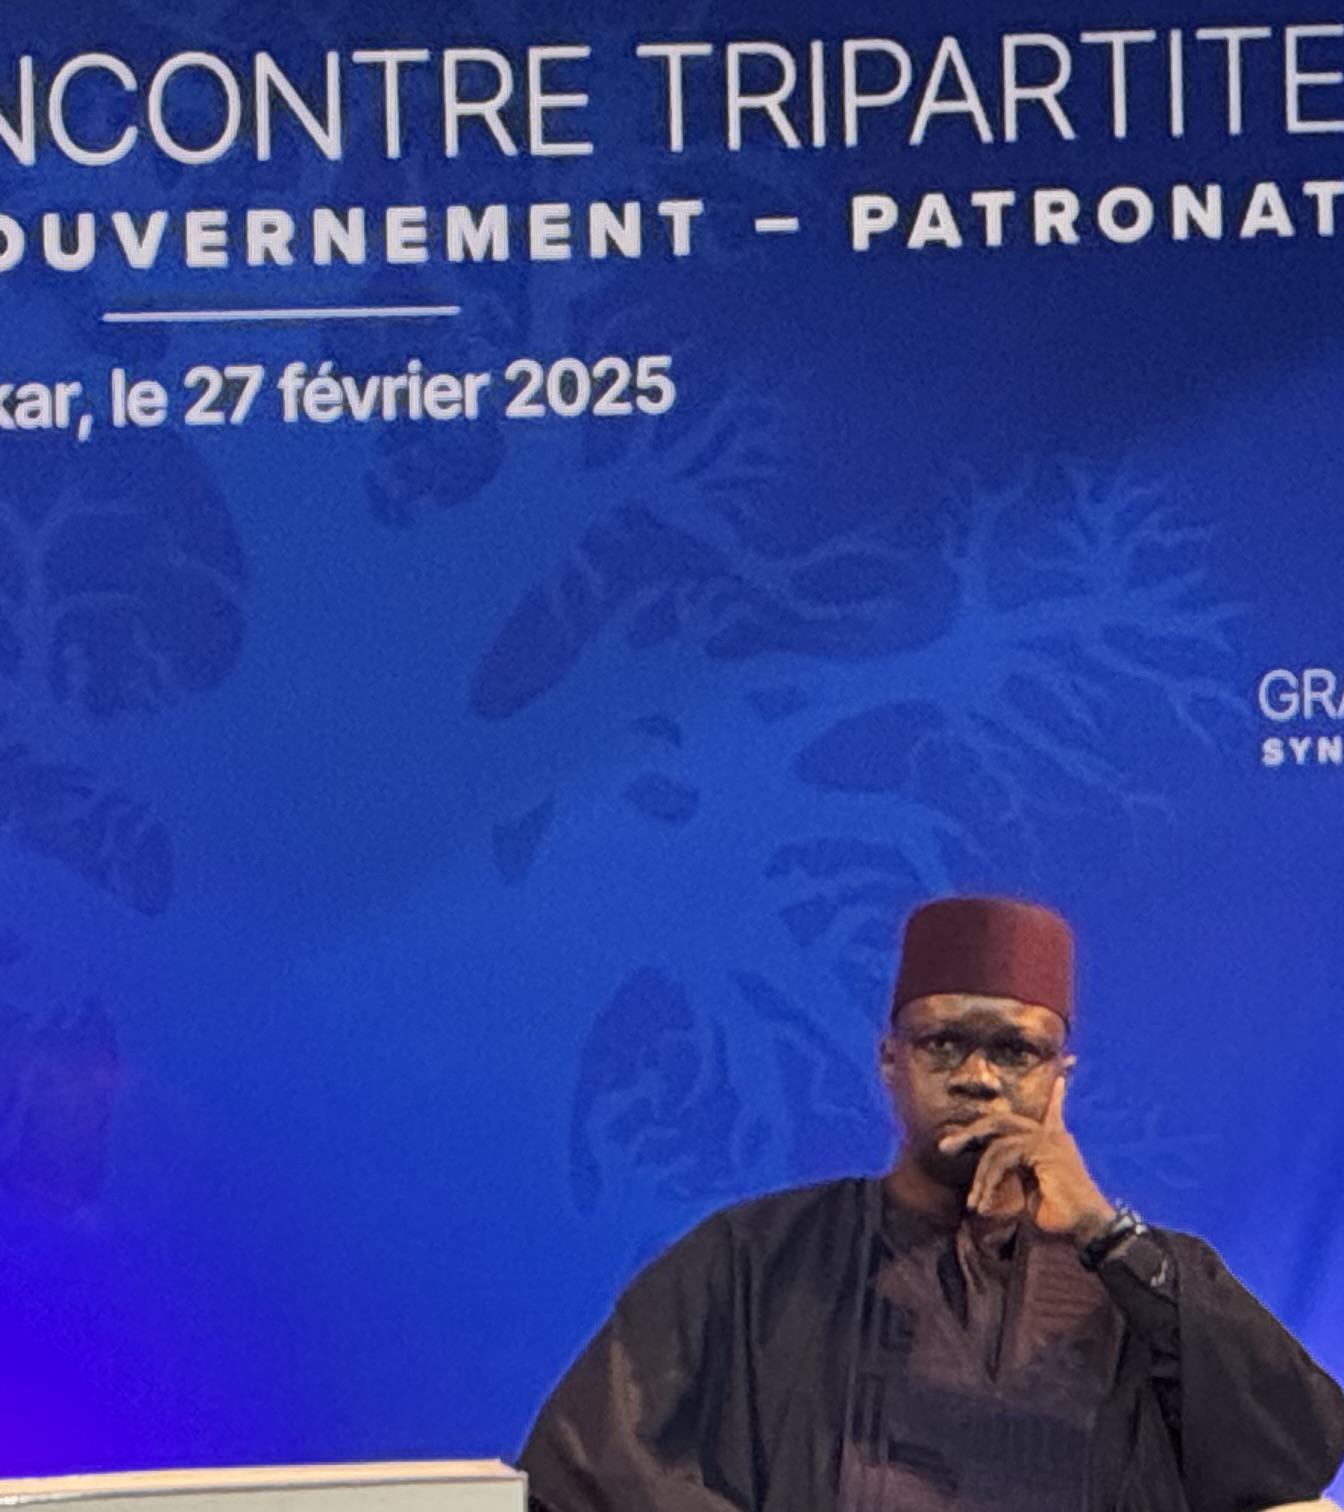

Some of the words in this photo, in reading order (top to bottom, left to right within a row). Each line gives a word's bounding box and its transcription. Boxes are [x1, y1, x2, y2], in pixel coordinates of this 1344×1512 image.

[111, 369, 168, 427] le
[184, 366, 265, 426] 27
[277, 359, 491, 423] février
[504, 355, 676, 418] 2025
